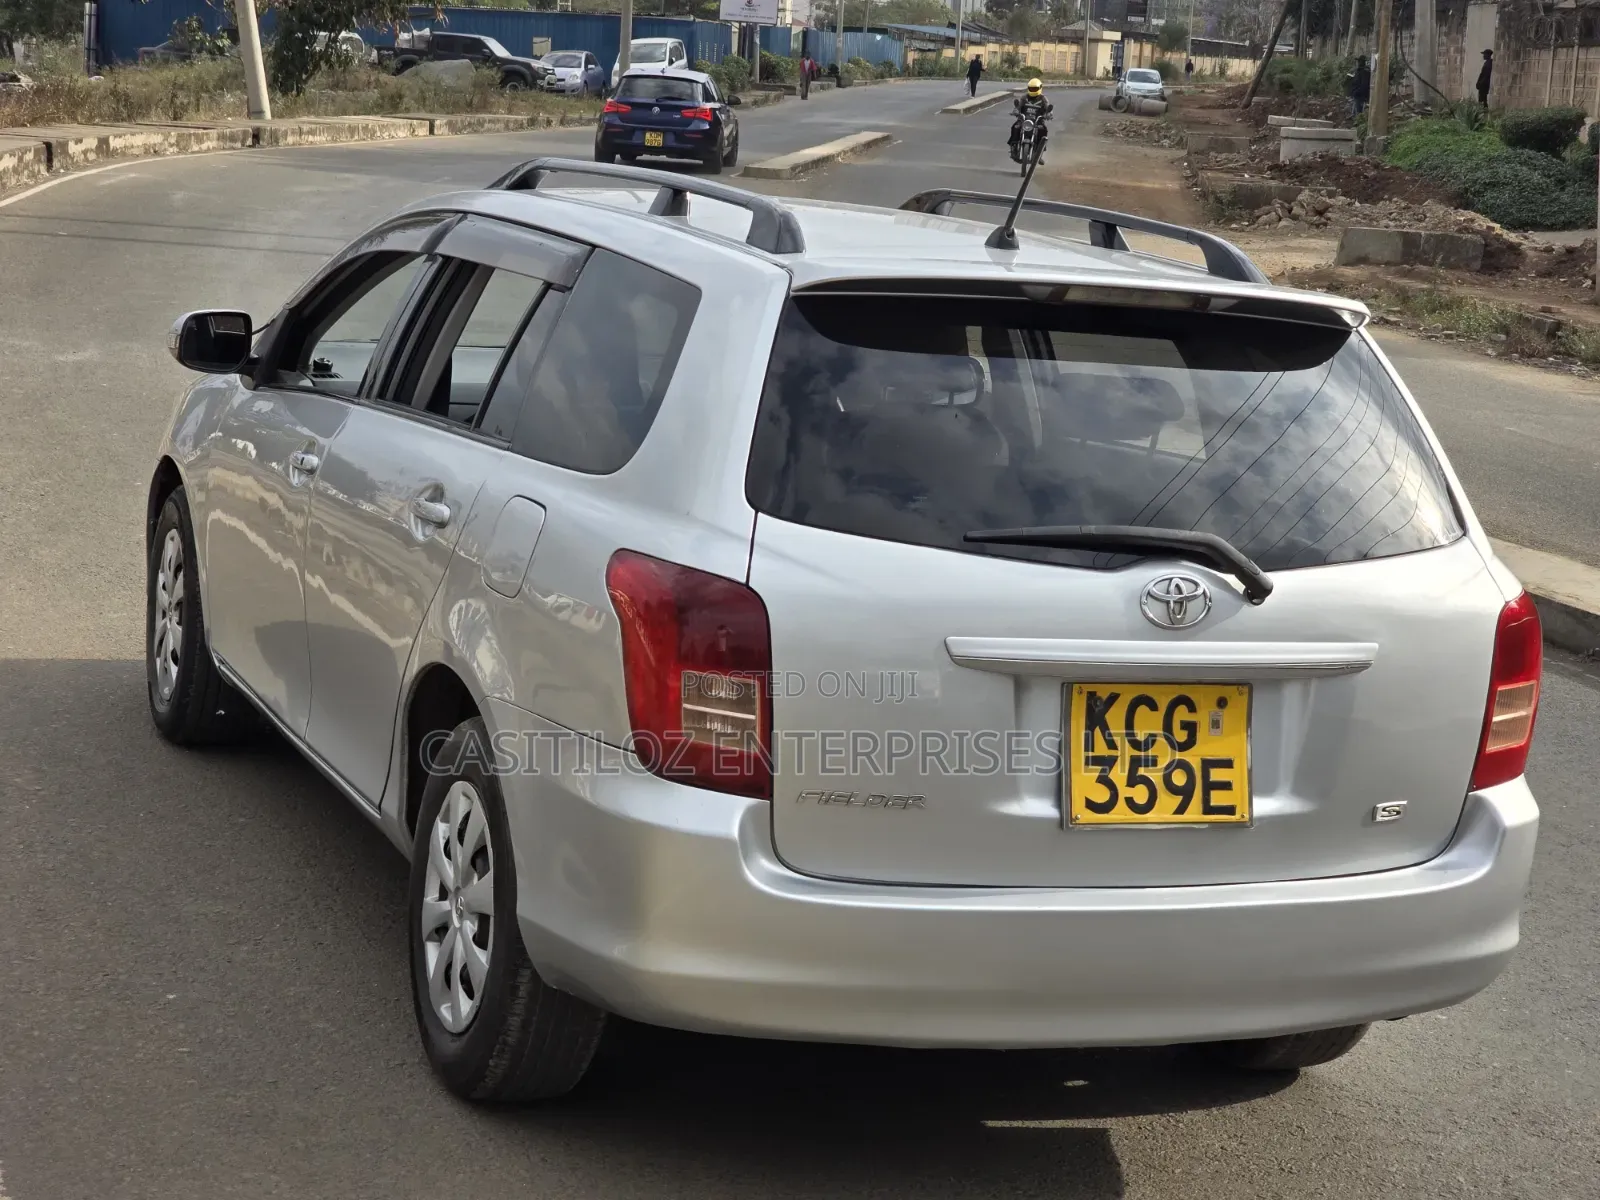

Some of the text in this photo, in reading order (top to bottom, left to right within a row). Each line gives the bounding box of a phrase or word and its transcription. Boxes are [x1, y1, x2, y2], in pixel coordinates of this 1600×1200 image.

[1084, 691, 1198, 752] KCG
[795, 788, 927, 810] FIELDER
[1084, 755, 1237, 816] 359E
